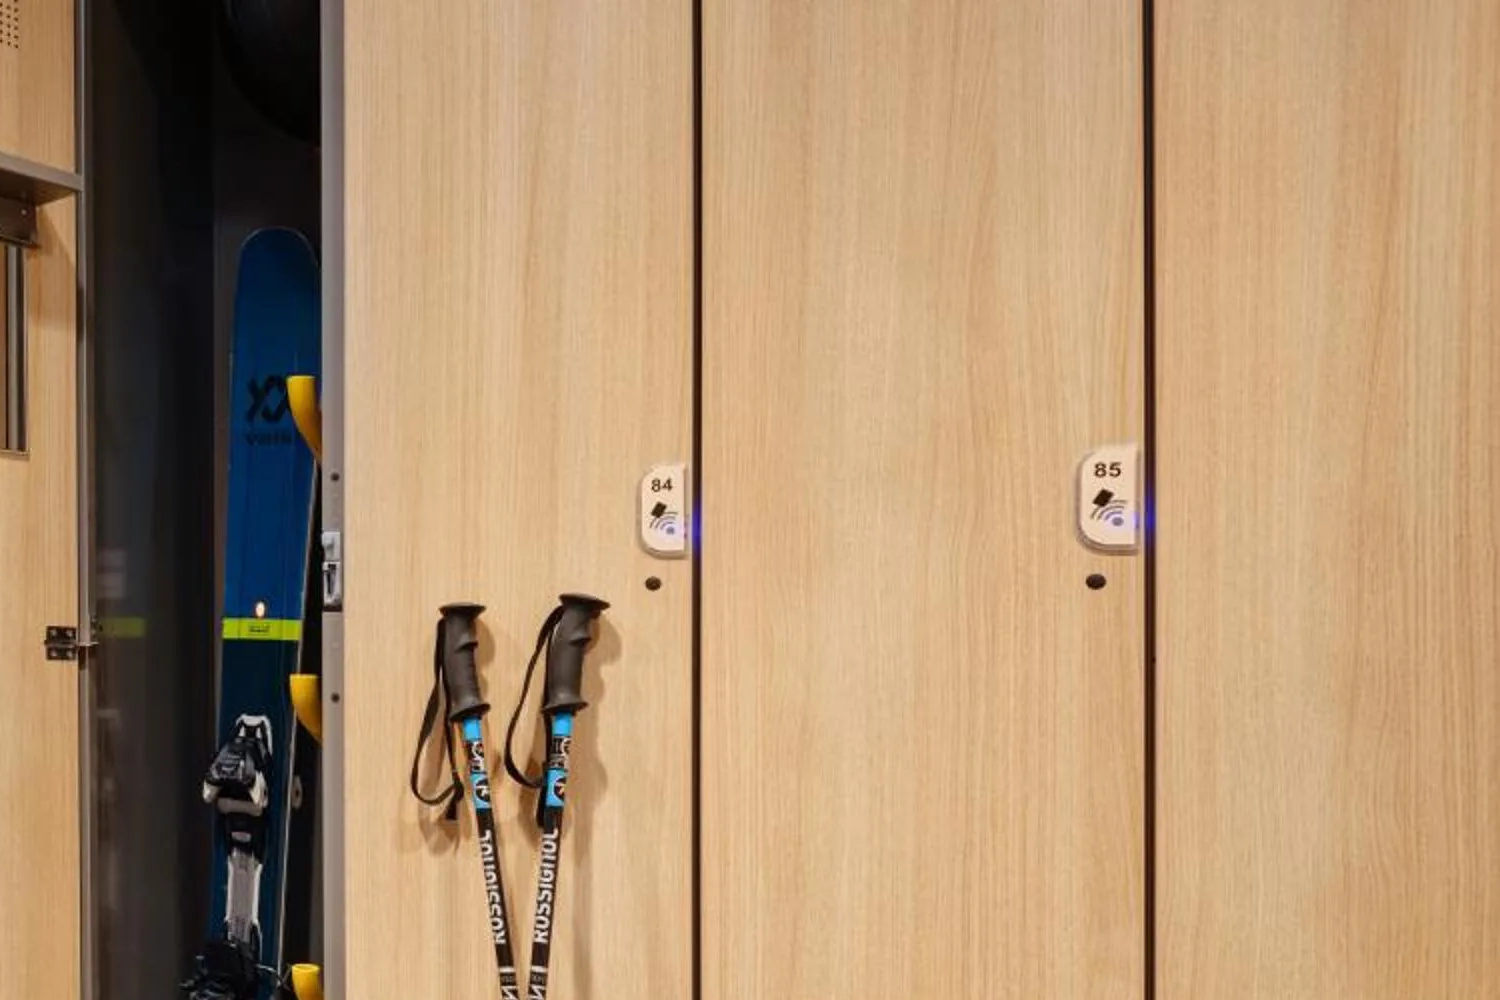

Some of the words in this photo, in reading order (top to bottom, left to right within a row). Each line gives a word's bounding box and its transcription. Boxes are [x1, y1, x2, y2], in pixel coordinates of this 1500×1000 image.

[1094, 461, 1122, 478] 85
[651, 477, 673, 492] 84
[533, 828, 559, 943] ROSSIGNOL
